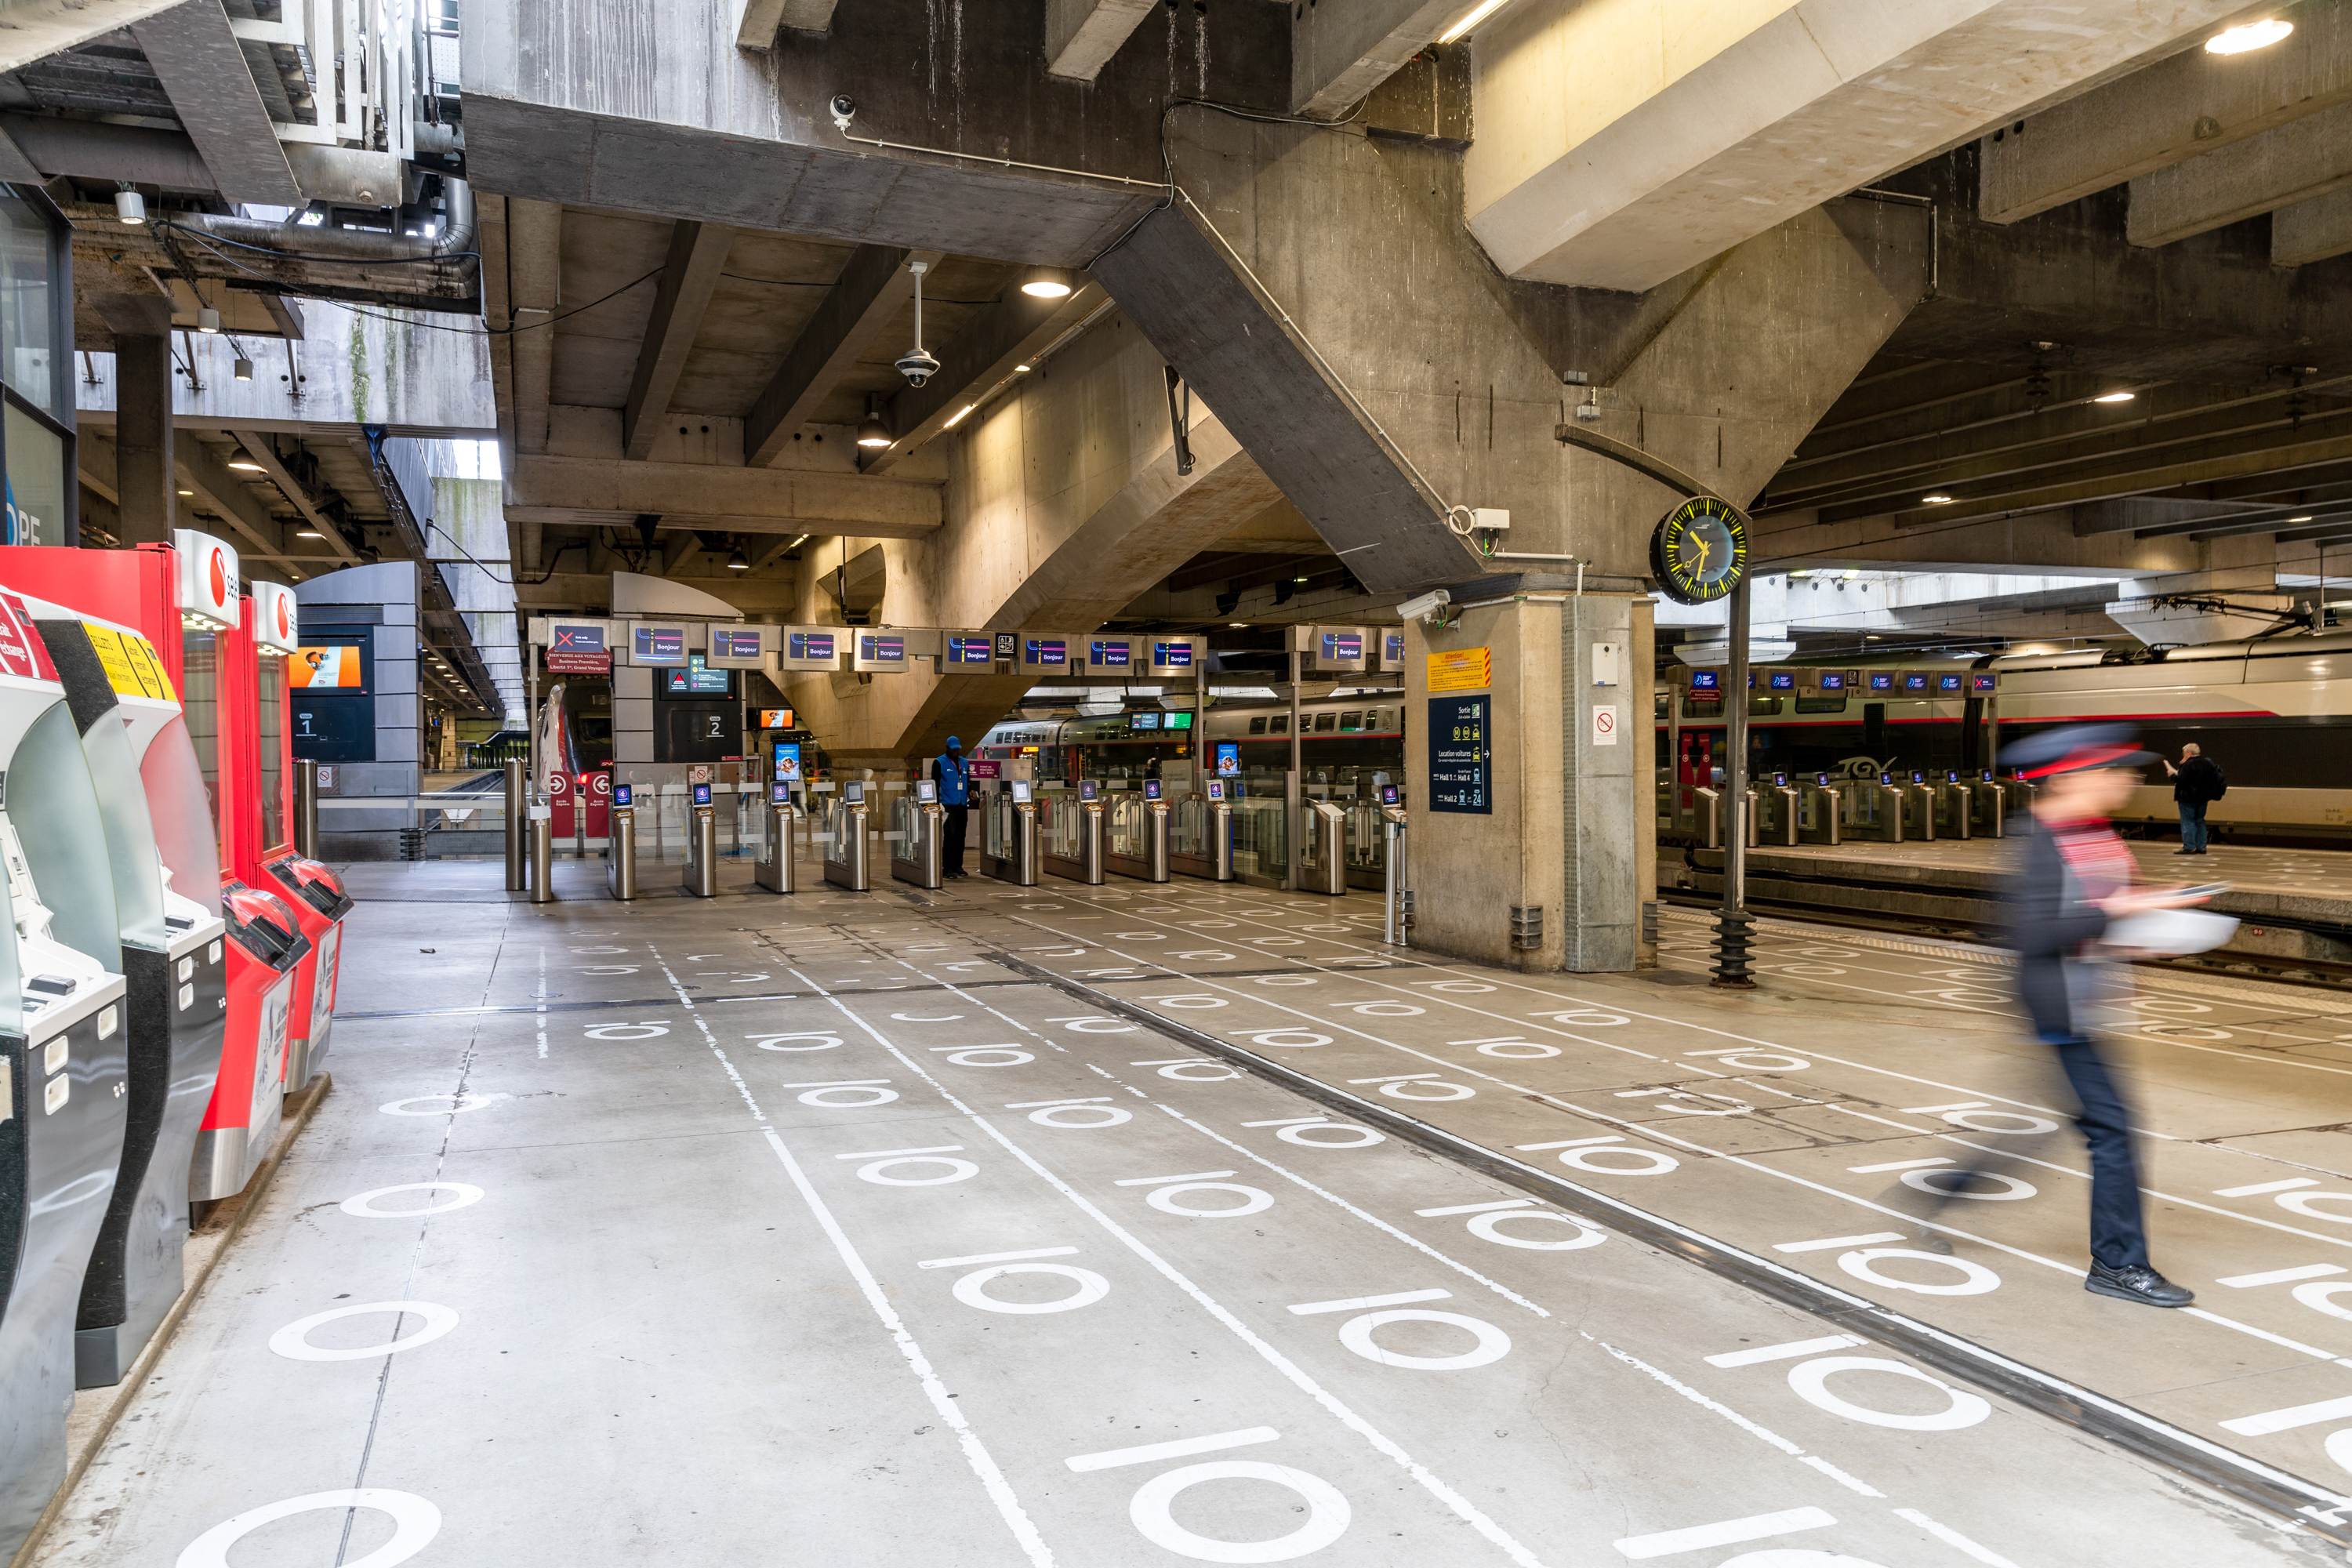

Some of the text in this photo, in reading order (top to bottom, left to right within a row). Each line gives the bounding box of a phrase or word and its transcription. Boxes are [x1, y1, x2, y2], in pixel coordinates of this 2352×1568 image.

[735, 646, 757, 655] Bonjour
[809, 648, 831, 656] Bonjour
[880, 649, 901, 658] Bonjour
[967, 652, 988, 660] Bonjour
[302, 720, 310, 734] 1
[711, 722, 720, 735] 2
[1473, 794, 1482, 804] 24
